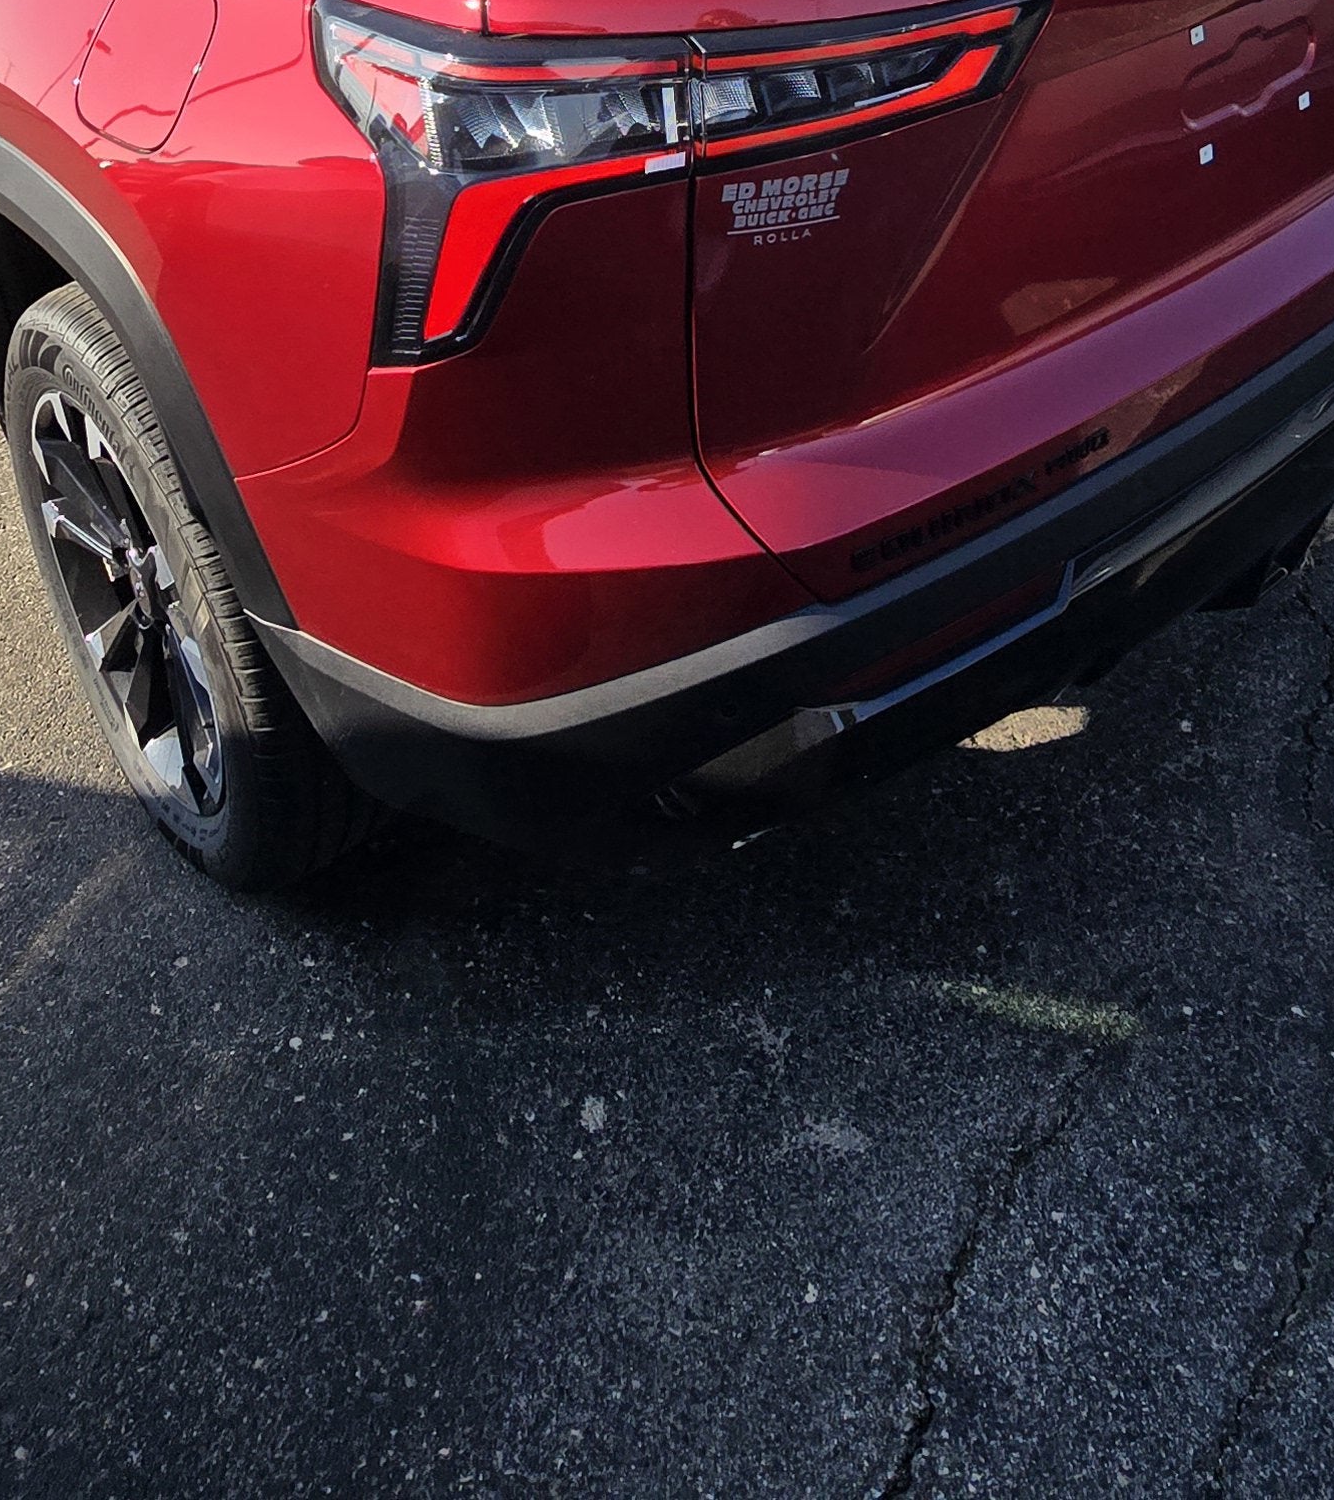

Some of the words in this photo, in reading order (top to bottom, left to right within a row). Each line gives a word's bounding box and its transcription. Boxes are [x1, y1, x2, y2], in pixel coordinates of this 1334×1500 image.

[721, 181, 757, 203] ED
[760, 167, 850, 198] MORSE
[732, 186, 841, 215] CHEVROLET
[753, 228, 812, 246] ROLLA
